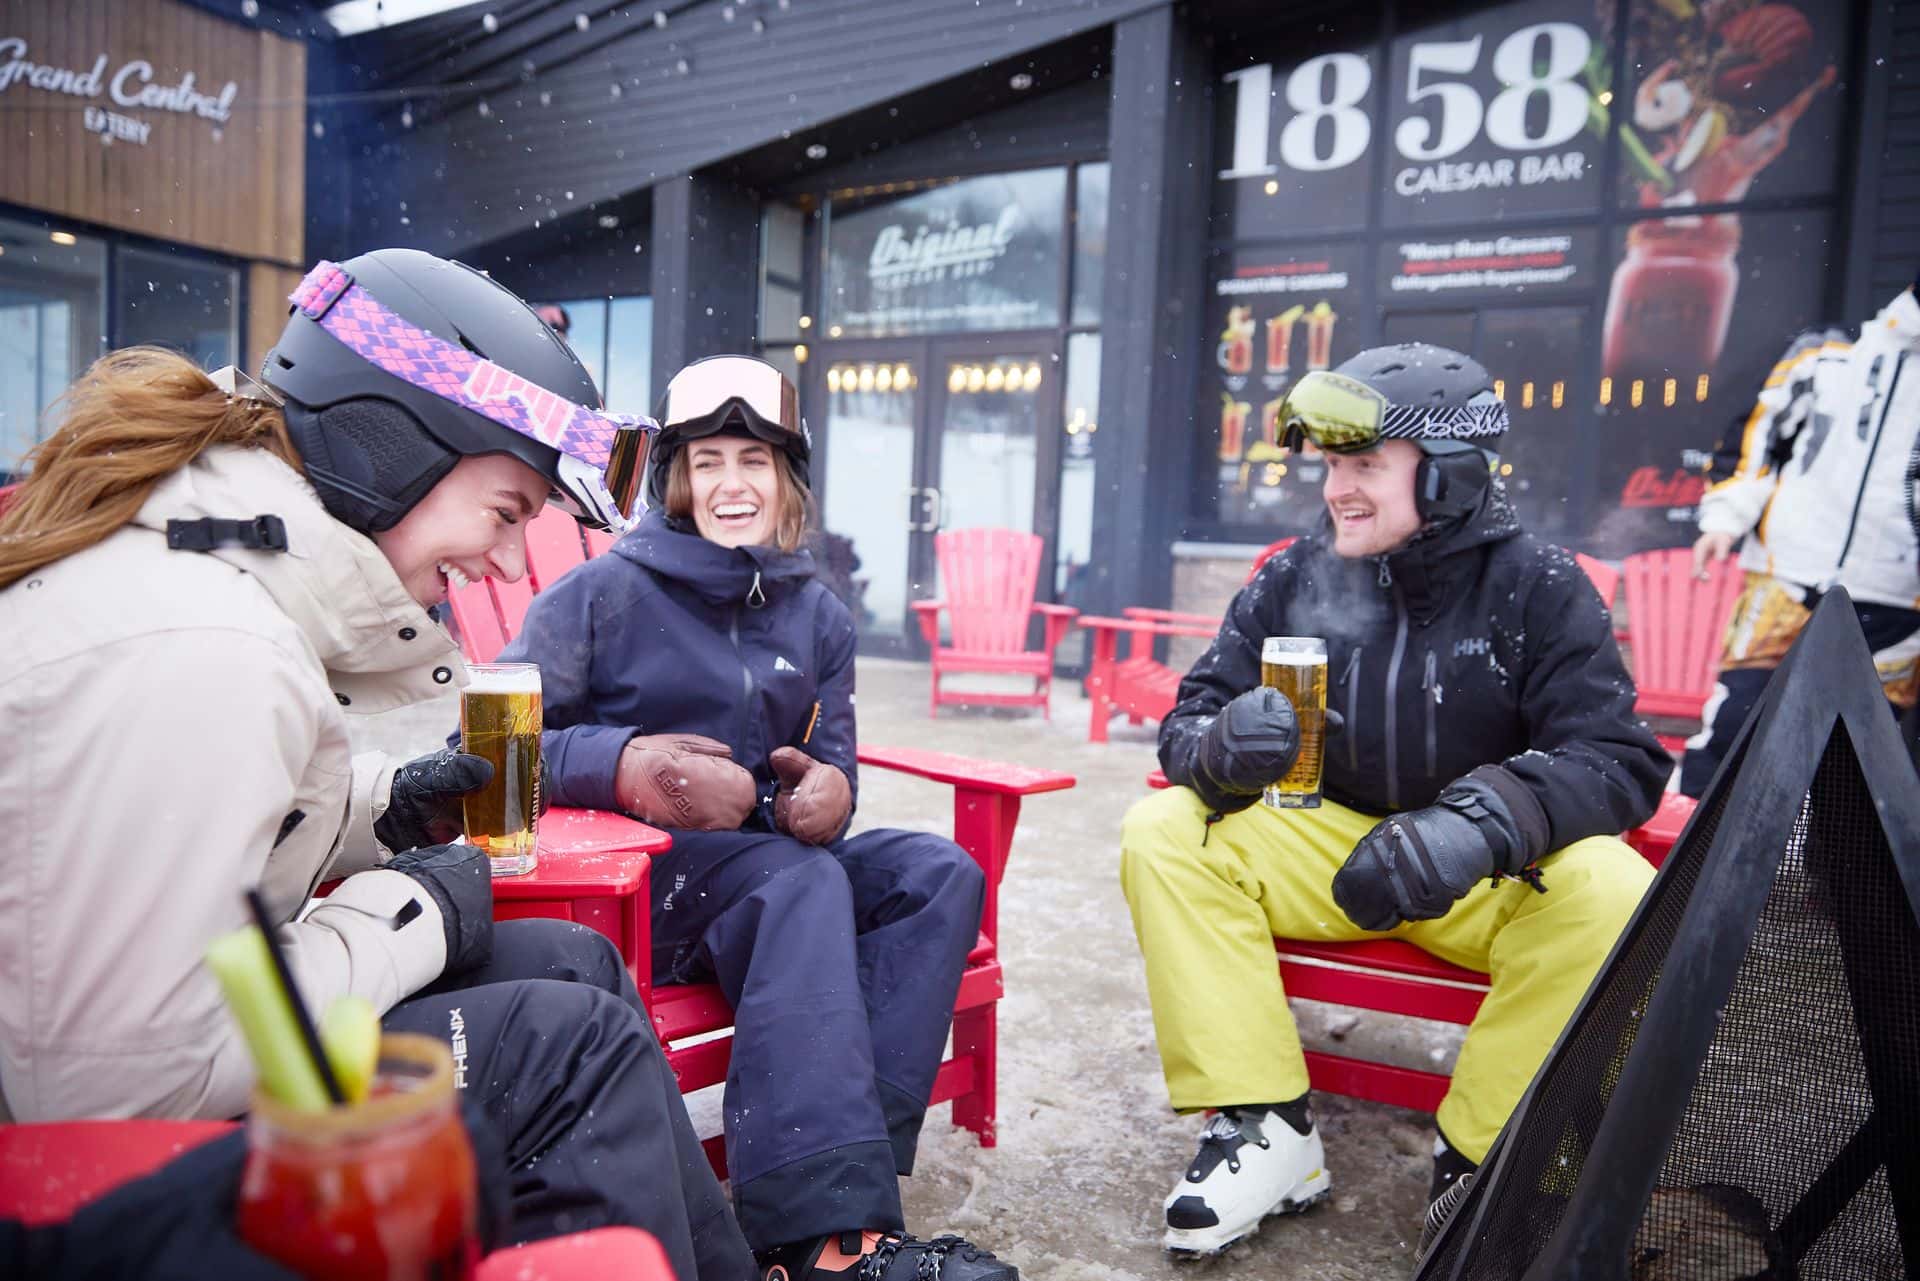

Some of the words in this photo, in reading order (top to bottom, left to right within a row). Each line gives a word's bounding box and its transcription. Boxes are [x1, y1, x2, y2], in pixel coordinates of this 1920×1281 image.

[0, 37, 108, 97] Grand
[110, 60, 238, 122] Central
[1218, 22, 1593, 179] 1858
[1395, 157, 1513, 195] CAESAR
[1519, 152, 1584, 185] BAR
[869, 202, 1020, 275] Original
[656, 767, 693, 819] LEVEL
[449, 1008, 468, 1089] PHENIX
